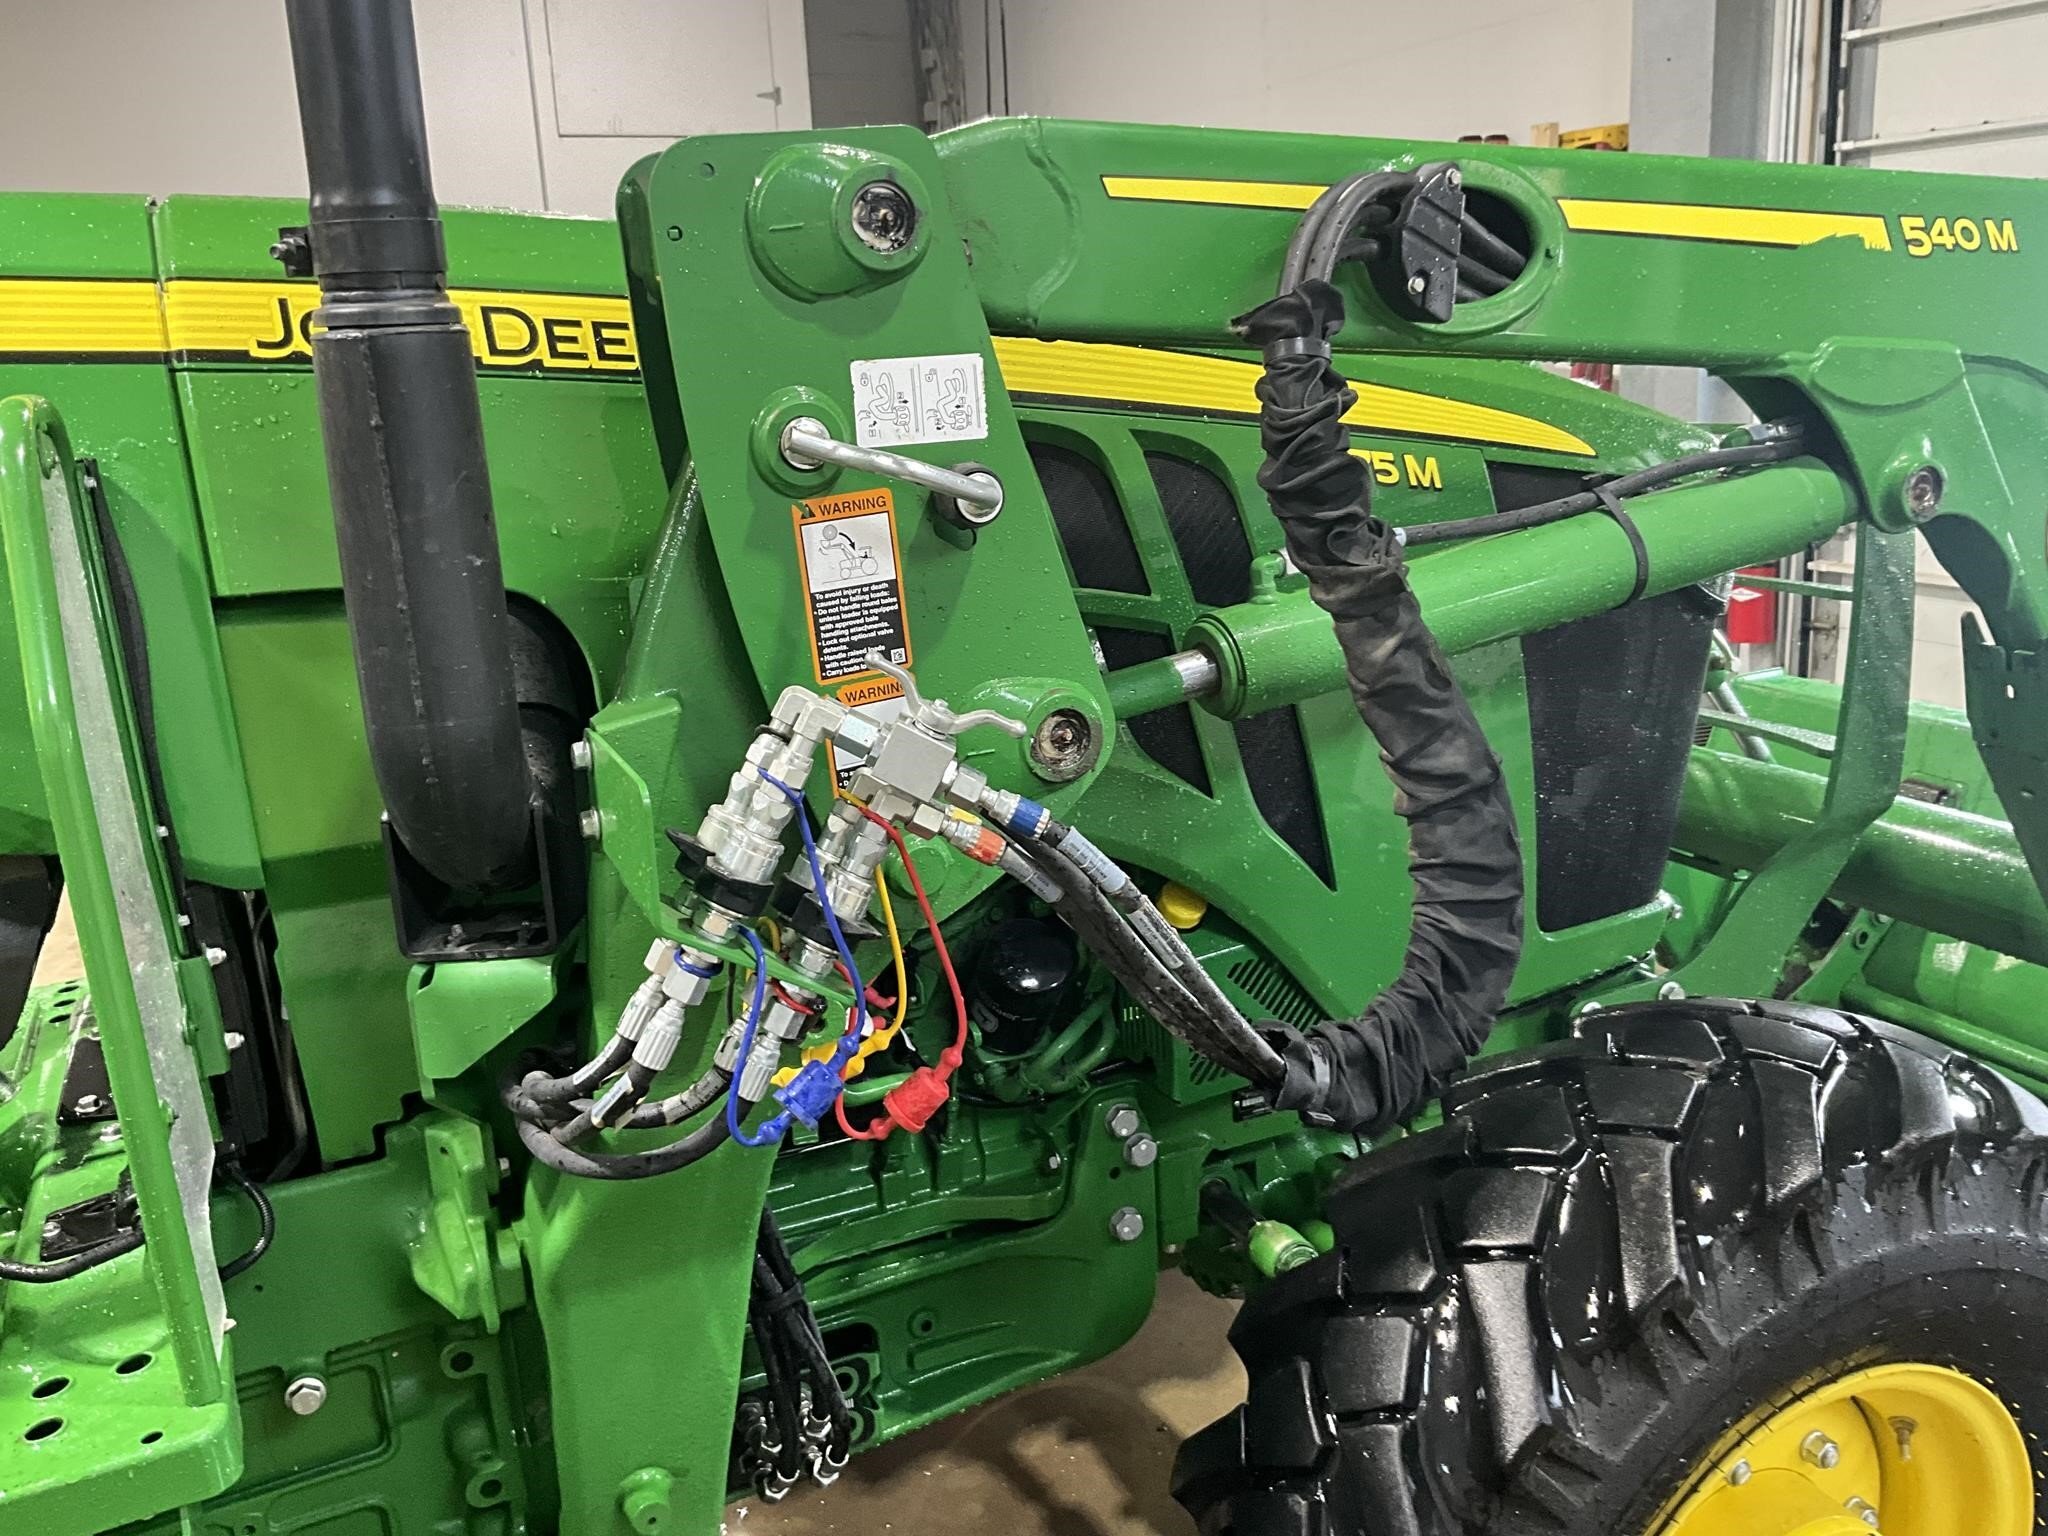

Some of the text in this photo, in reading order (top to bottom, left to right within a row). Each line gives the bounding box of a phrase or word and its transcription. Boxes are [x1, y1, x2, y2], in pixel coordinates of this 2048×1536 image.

[1899, 216, 2019, 258] 540 M
[1403, 454, 1443, 490] M
[819, 496, 887, 516] WARNING
[824, 590, 842, 599] avoid
[843, 587, 861, 596] injury
[870, 582, 889, 590] death
[816, 599, 840, 608] caused
[850, 594, 869, 602] falling
[840, 602, 860, 611] handle
[862, 599, 880, 607] round
[819, 615, 840, 623] unless
[841, 611, 861, 619] loader
[869, 603, 898, 614] equipped
[834, 617, 864, 628] approved
[865, 615, 879, 623] bale
[821, 628, 849, 638] handling
[850, 631, 876, 641] optional
[877, 628, 894, 636] valve
[824, 652, 846, 661] Handle
[848, 648, 867, 657] raised
[826, 669, 843, 677] Carry
[844, 665, 860, 673] loads
[845, 682, 904, 702] WARNIN
